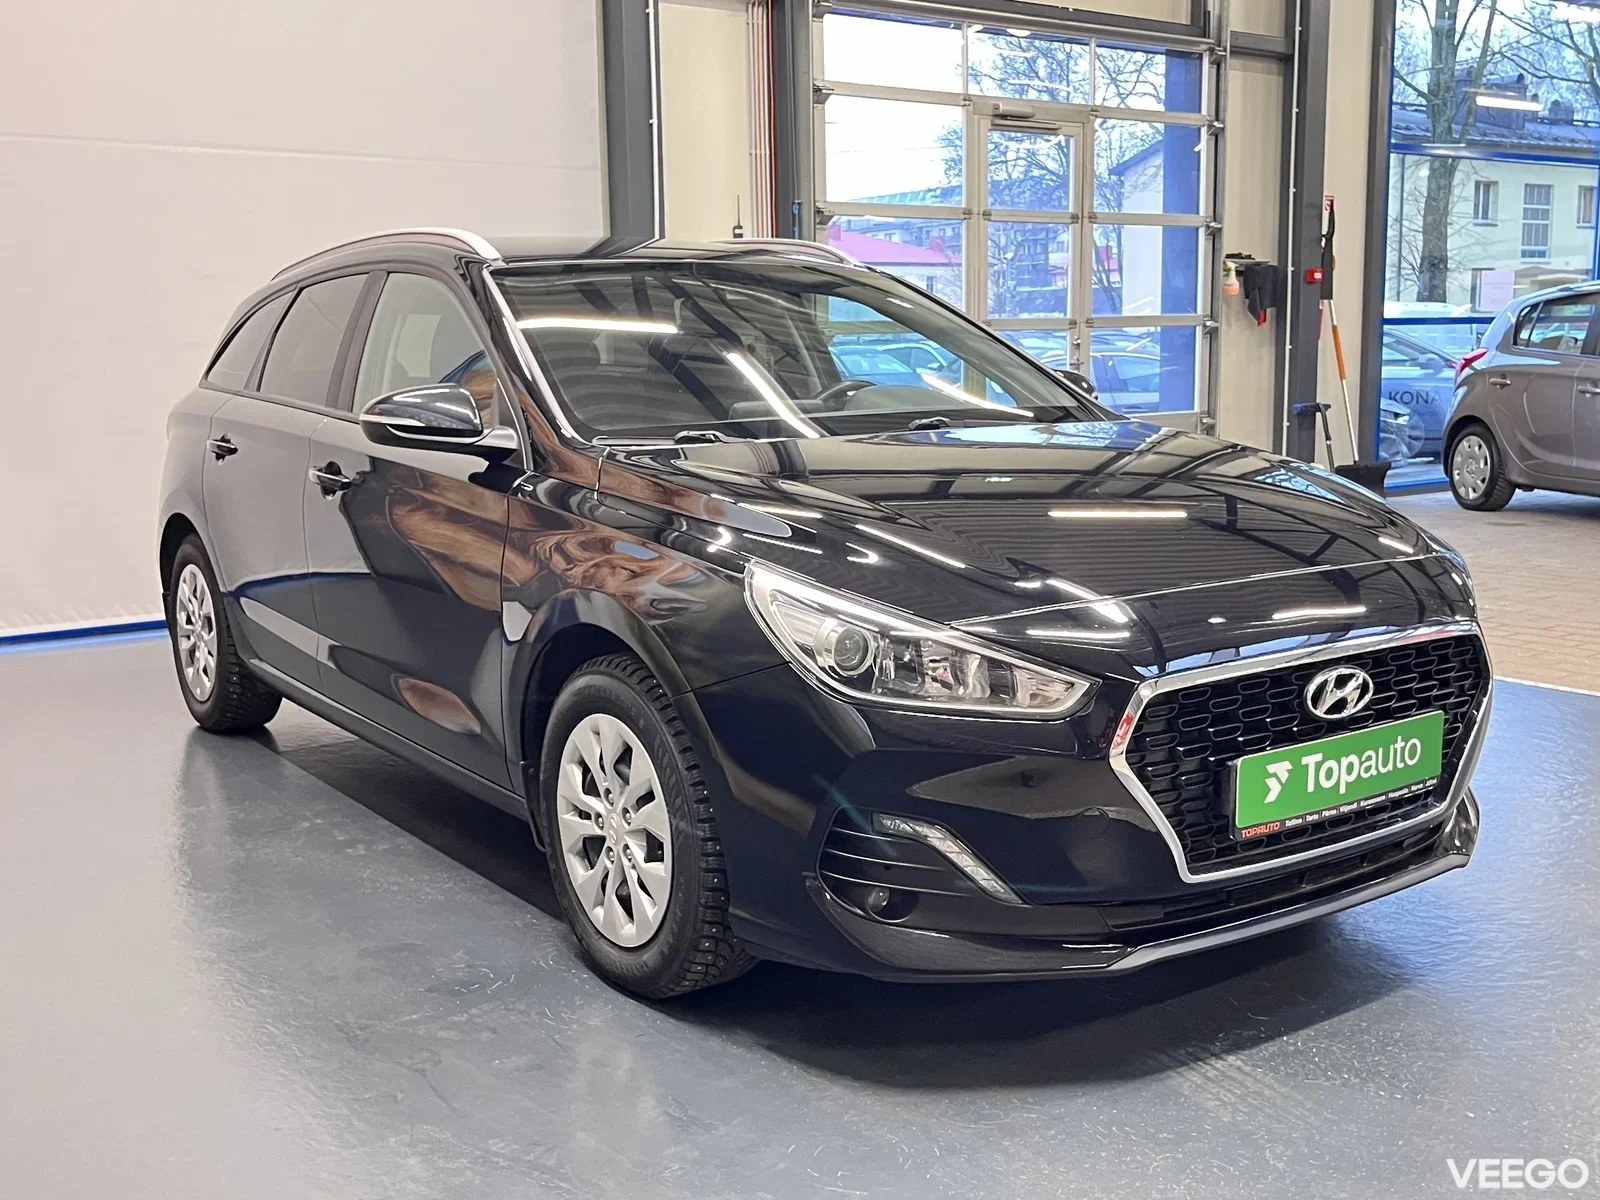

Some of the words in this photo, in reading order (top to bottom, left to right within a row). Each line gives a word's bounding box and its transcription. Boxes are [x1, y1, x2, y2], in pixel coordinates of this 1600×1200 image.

[1301, 735, 1421, 794] Topauto
[1241, 822, 1280, 838] TOPAUTO
[1305, 814, 1319, 822] Tartu
